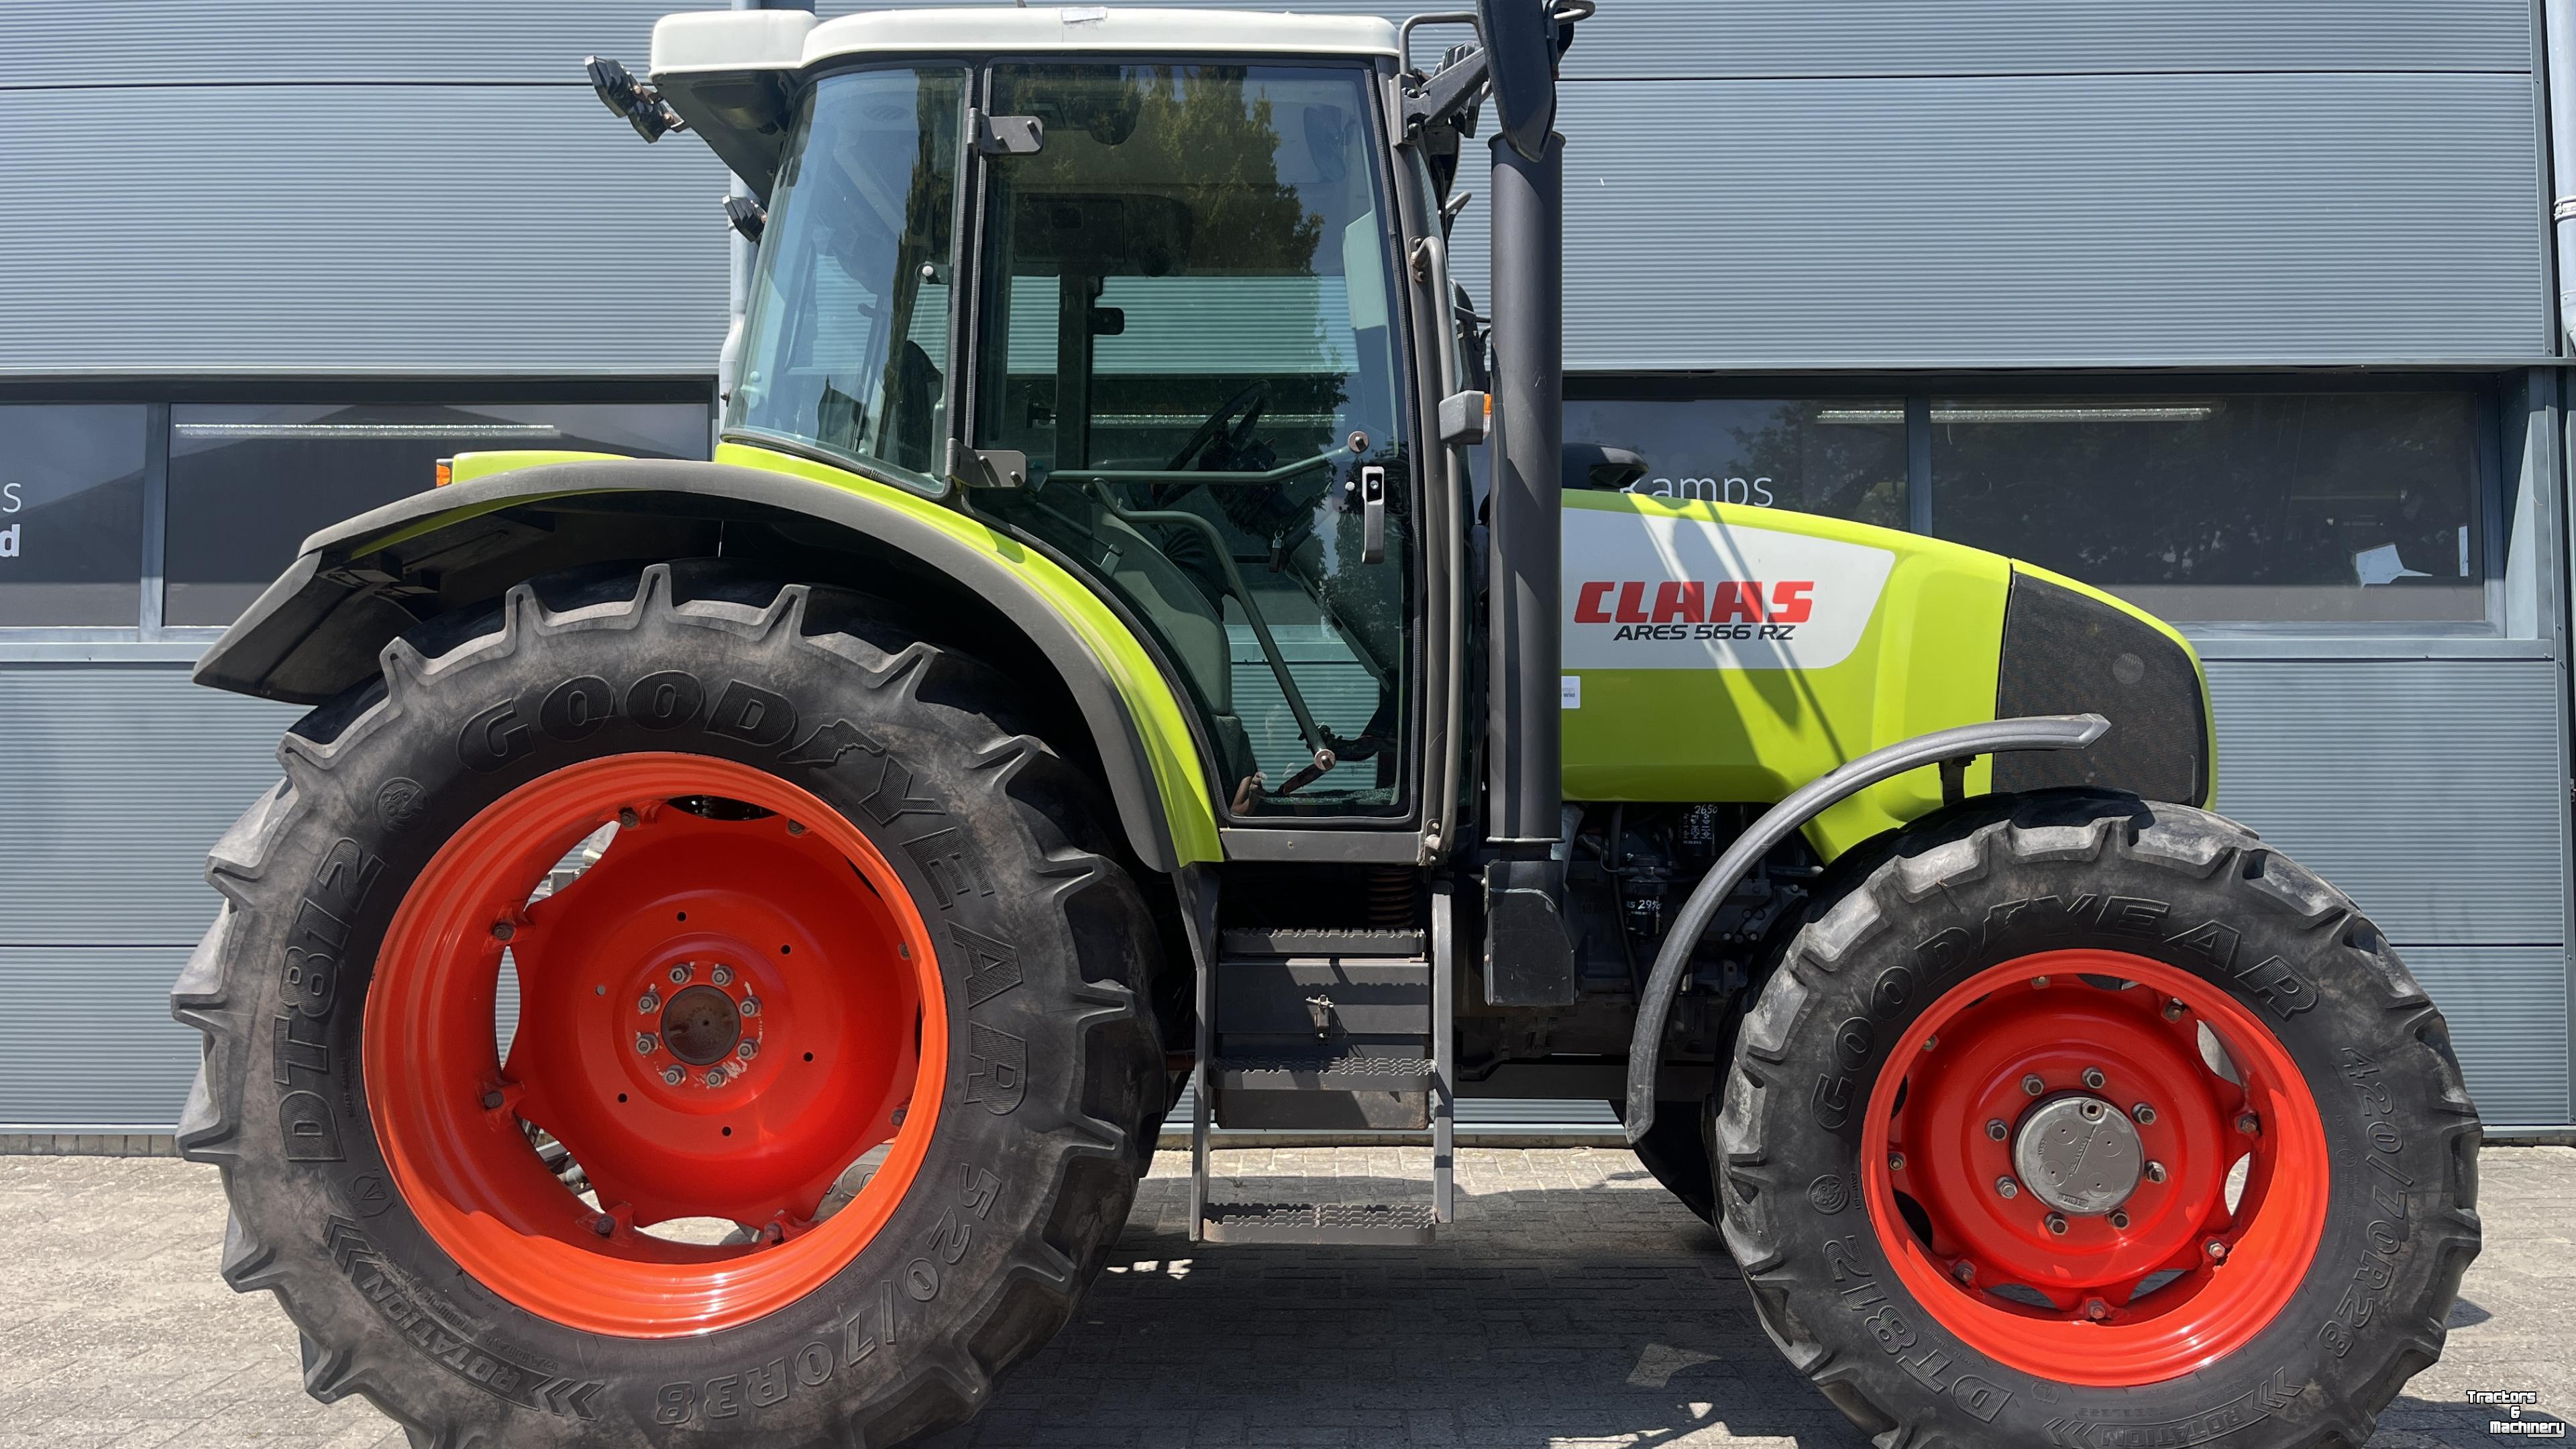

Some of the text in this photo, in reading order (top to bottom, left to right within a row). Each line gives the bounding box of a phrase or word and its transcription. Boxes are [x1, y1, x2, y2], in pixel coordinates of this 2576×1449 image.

[1574, 581, 1815, 624] CLAAS
[1613, 624, 1796, 641] ARES 566 RZ
[456, 669, 1029, 1116] GOODYEAR
[1694, 804, 1718, 814] 2650
[273, 837, 386, 1162] DT812
[1811, 893, 2320, 1130] GOODYEAR
[655, 1162, 1002, 1426] 520/70R38
[2317, 1047, 2414, 1358] 420/70R28
[362, 1272, 521, 1393] ROTATION
[1822, 1234, 2014, 1424] DT812
[2101, 1405, 2245, 1447] ROTATION
